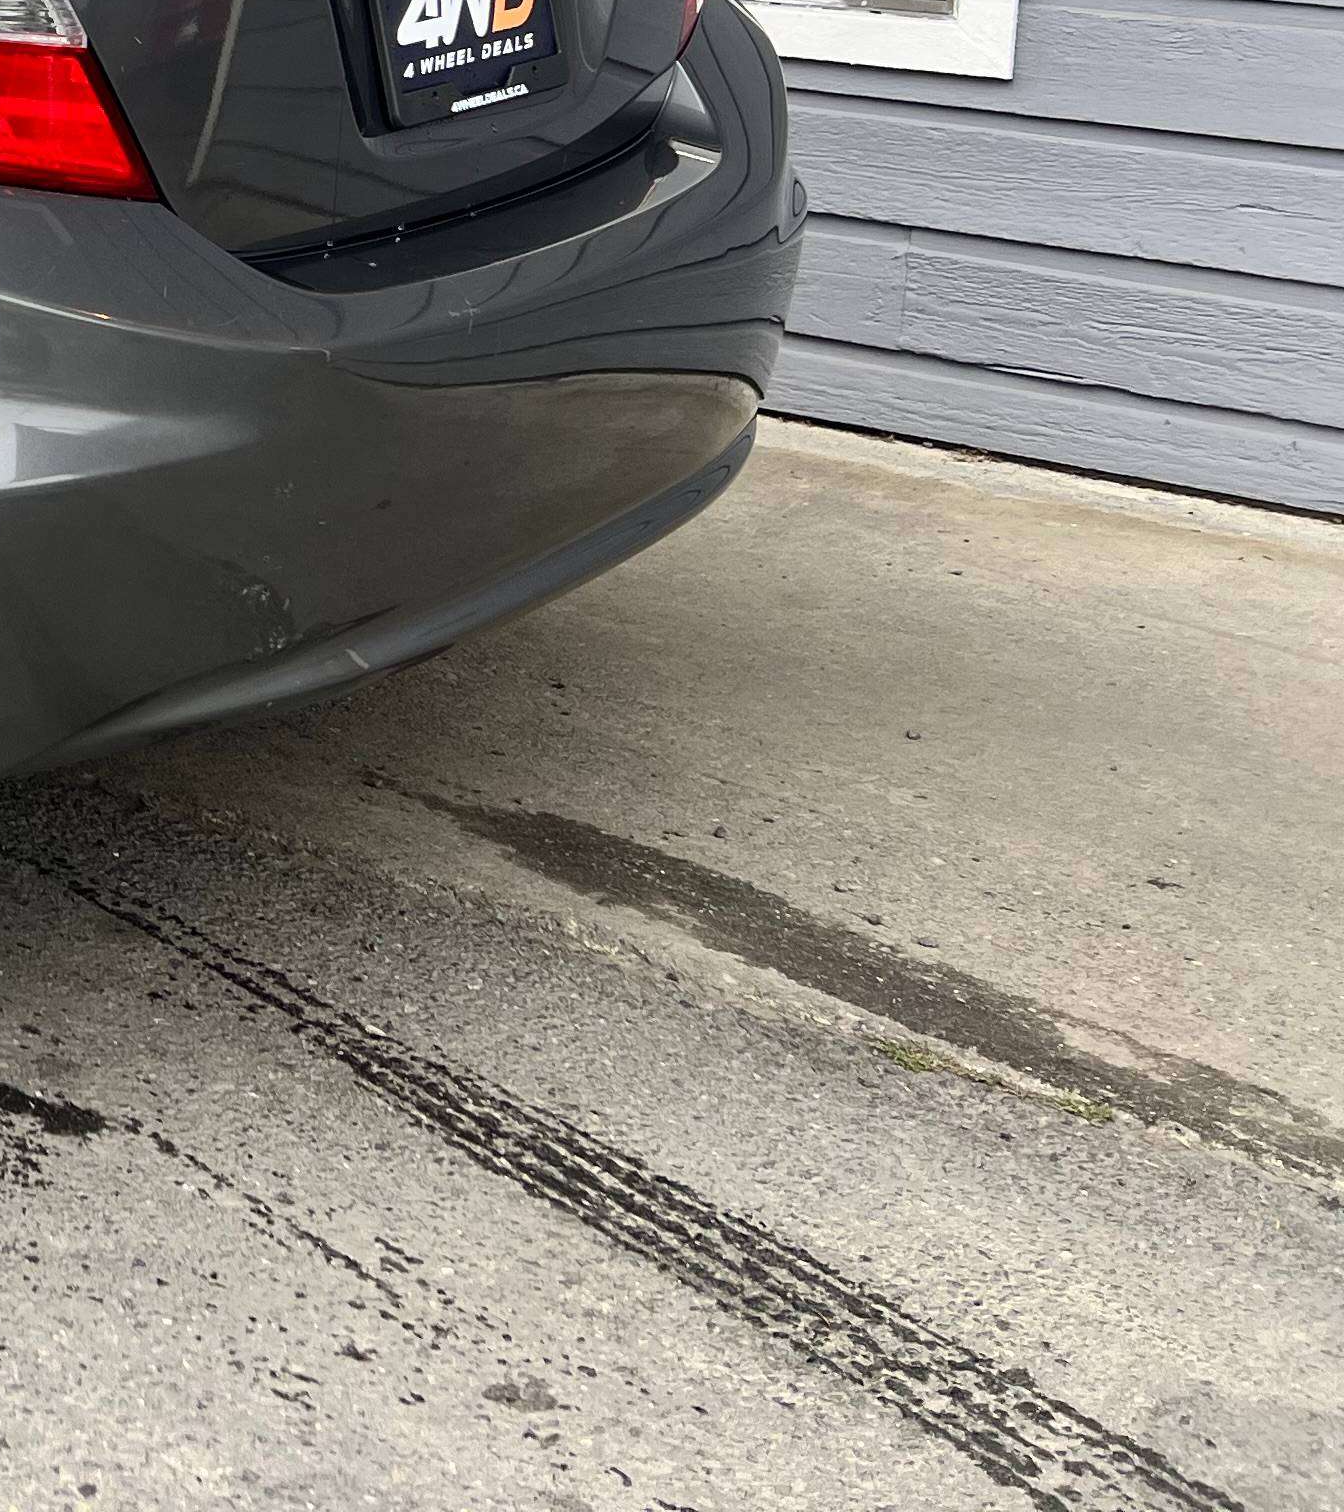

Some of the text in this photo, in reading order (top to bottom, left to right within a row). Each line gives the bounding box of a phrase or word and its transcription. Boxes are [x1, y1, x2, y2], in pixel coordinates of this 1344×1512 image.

[403, 32, 535, 78] 4 WHEEL DEALS
